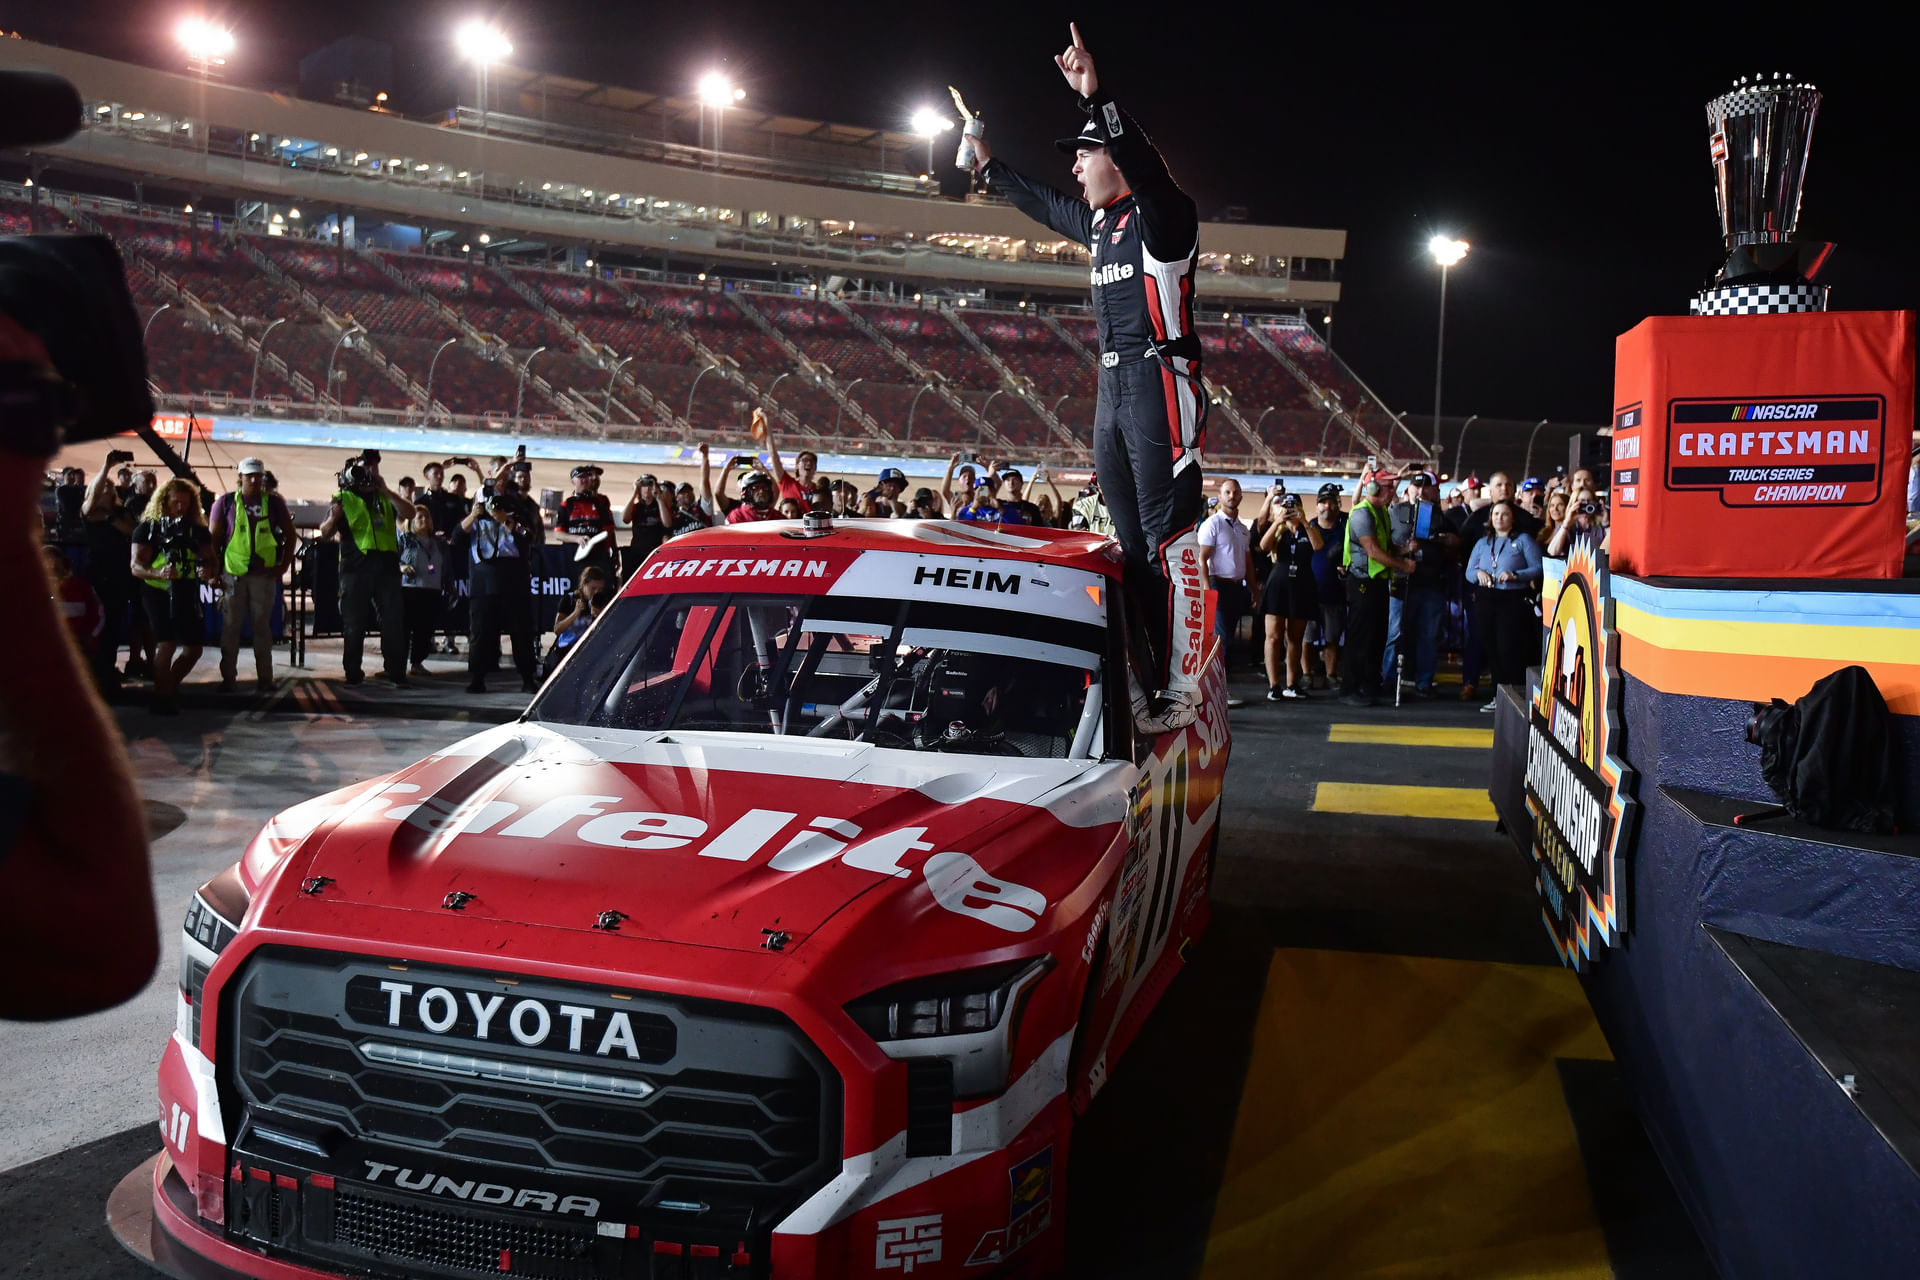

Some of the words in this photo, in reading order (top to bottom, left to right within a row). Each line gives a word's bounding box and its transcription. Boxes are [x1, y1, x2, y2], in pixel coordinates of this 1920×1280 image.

[153, 419, 184, 435] ABB
[1752, 404, 1818, 420] NASCAR
[1679, 430, 1869, 456] CRAFTSMAN
[1729, 469, 1770, 481] TRUCK
[1770, 468, 1815, 481] SERIES
[1754, 485, 1847, 501] CHAMPION
[643, 559, 827, 580] CRAFTSMAN
[913, 566, 1021, 595] HEIM
[1182, 548, 1202, 676] Safelite
[1553, 701, 1579, 759] NASCAR
[1527, 723, 1601, 876] CHAMPIONSHIP
[1537, 813, 1575, 893] WEEKEND
[379, 981, 641, 1060] TOYOTA
[169, 1102, 191, 1153] 11
[363, 1159, 601, 1217] TUNDRA
